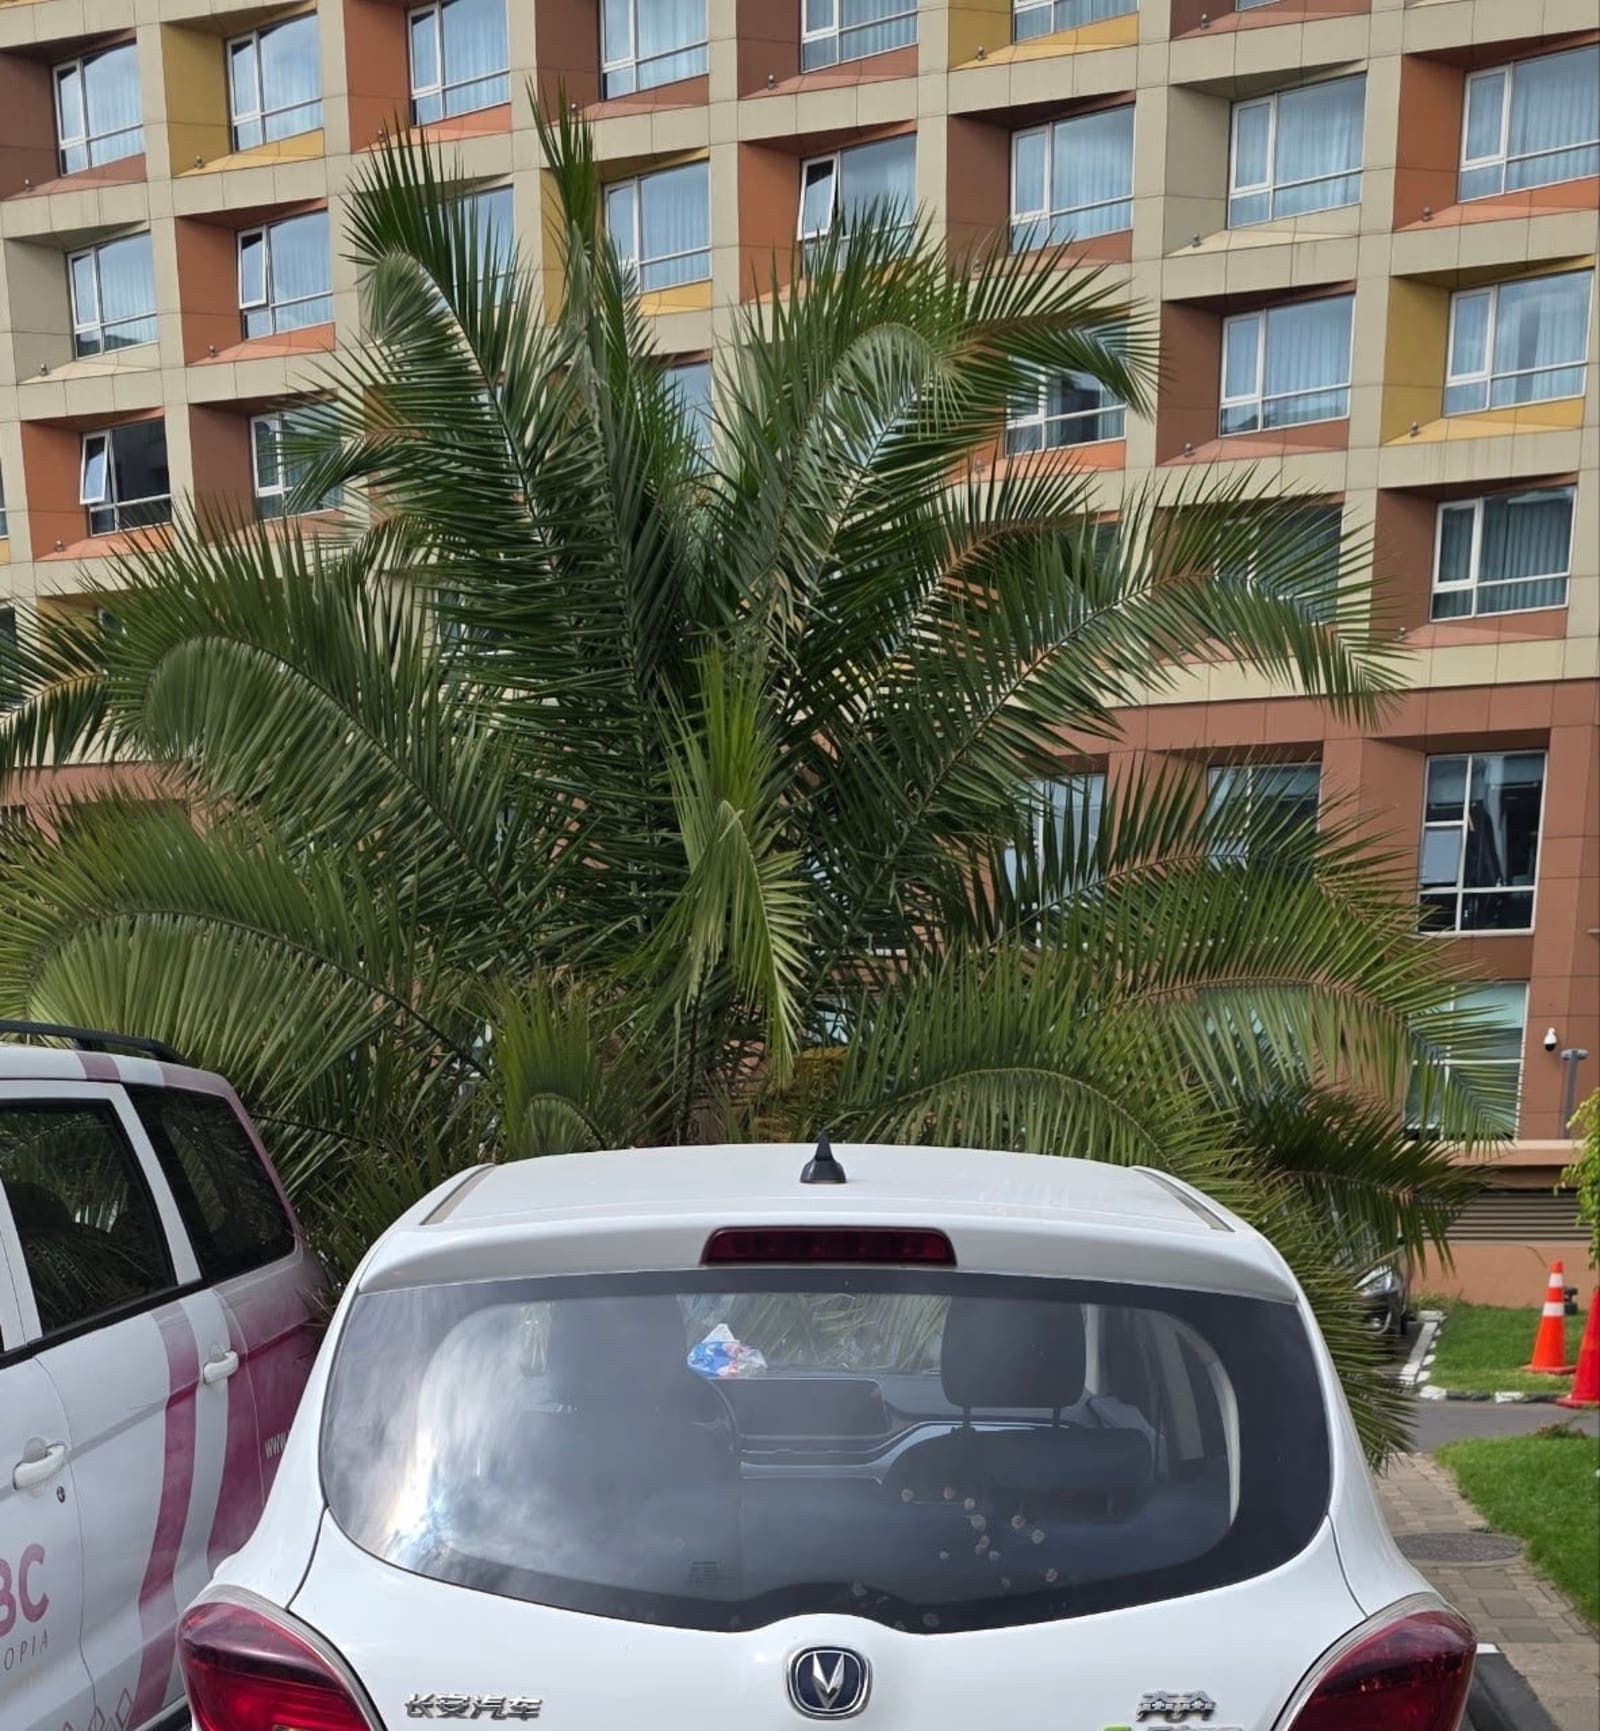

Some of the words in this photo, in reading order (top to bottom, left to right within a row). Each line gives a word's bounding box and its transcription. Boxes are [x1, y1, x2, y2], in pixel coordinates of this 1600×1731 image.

[3, 1628, 49, 1671] OPIA
[405, 1693, 542, 1721] 长安汽车
